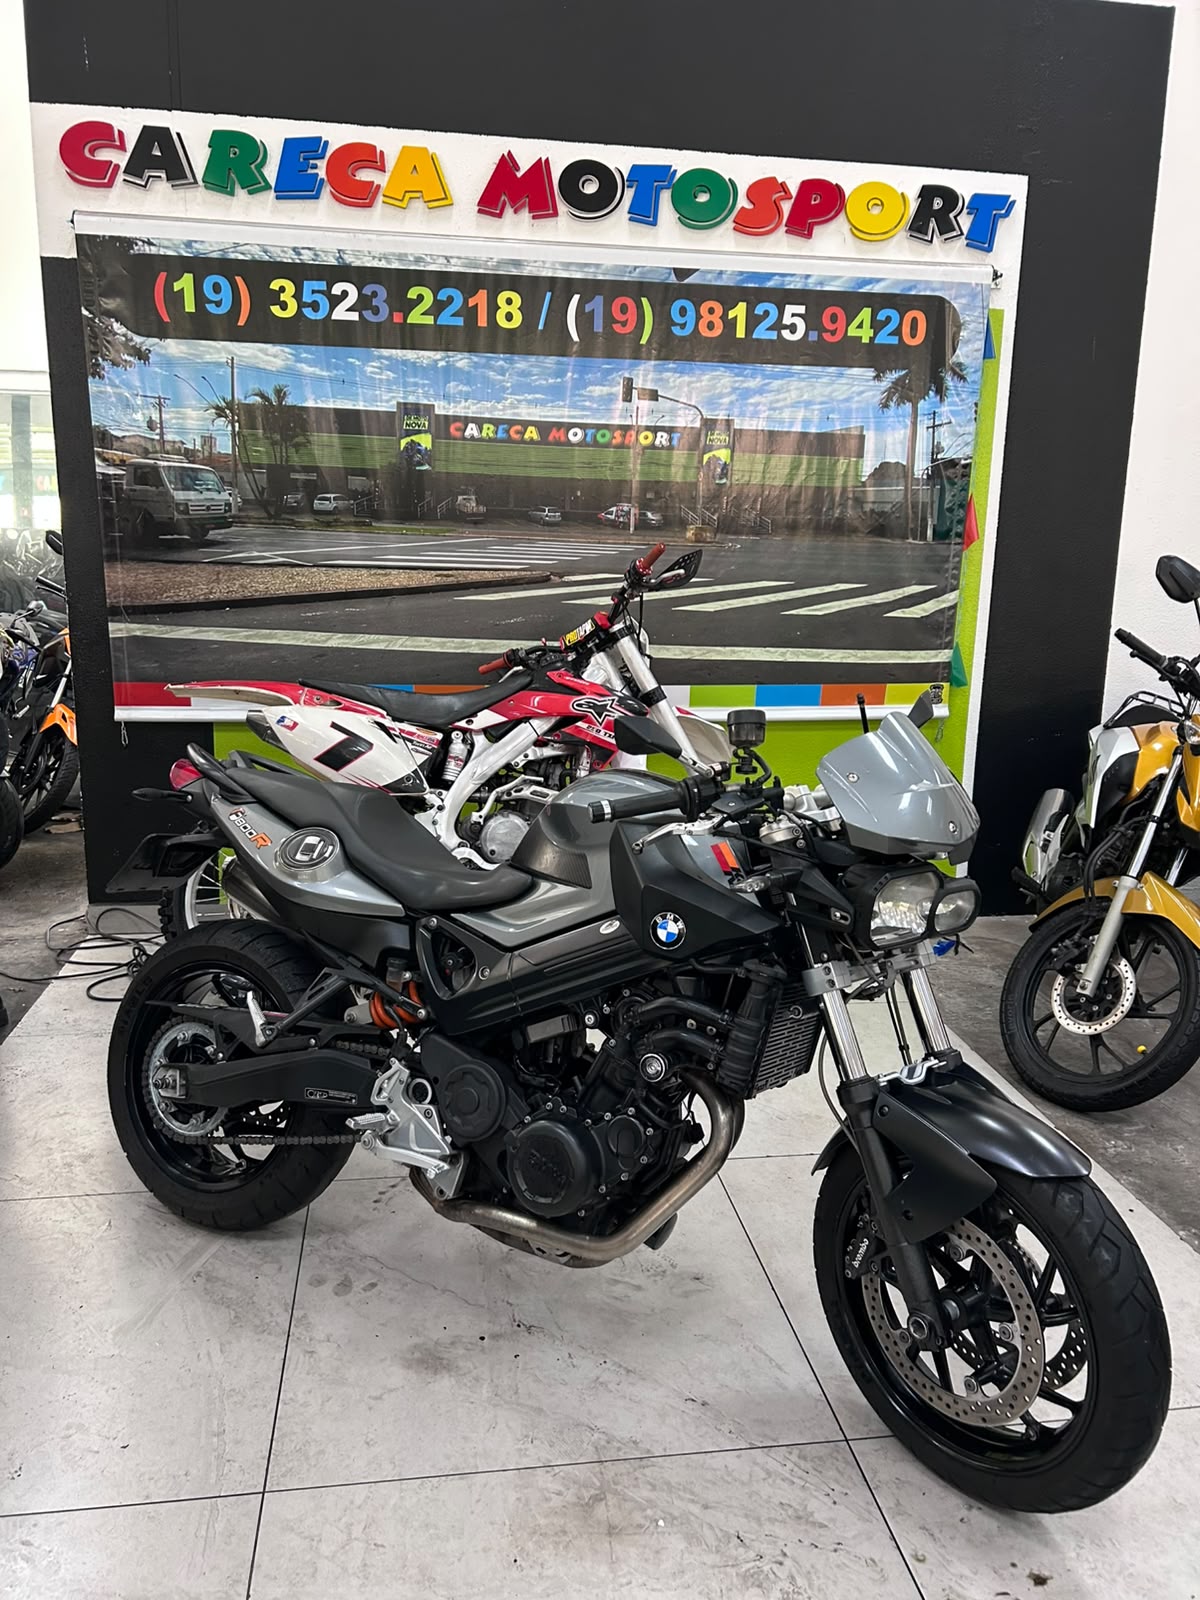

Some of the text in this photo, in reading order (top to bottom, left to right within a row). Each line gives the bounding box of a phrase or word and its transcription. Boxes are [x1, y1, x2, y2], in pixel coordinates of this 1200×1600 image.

[59, 120, 1017, 253] CARECA MOTOSPORT
[154, 271, 928, 347] (19) 3523.2218 / (19) 98125.9420
[404, 421, 428, 429] NOVA
[449, 421, 681, 448] CARECA MOTOSPORT
[229, 807, 272, 849] F800R
[655, 913, 686, 930] BMW
[851, 1238, 869, 1268] brembo
